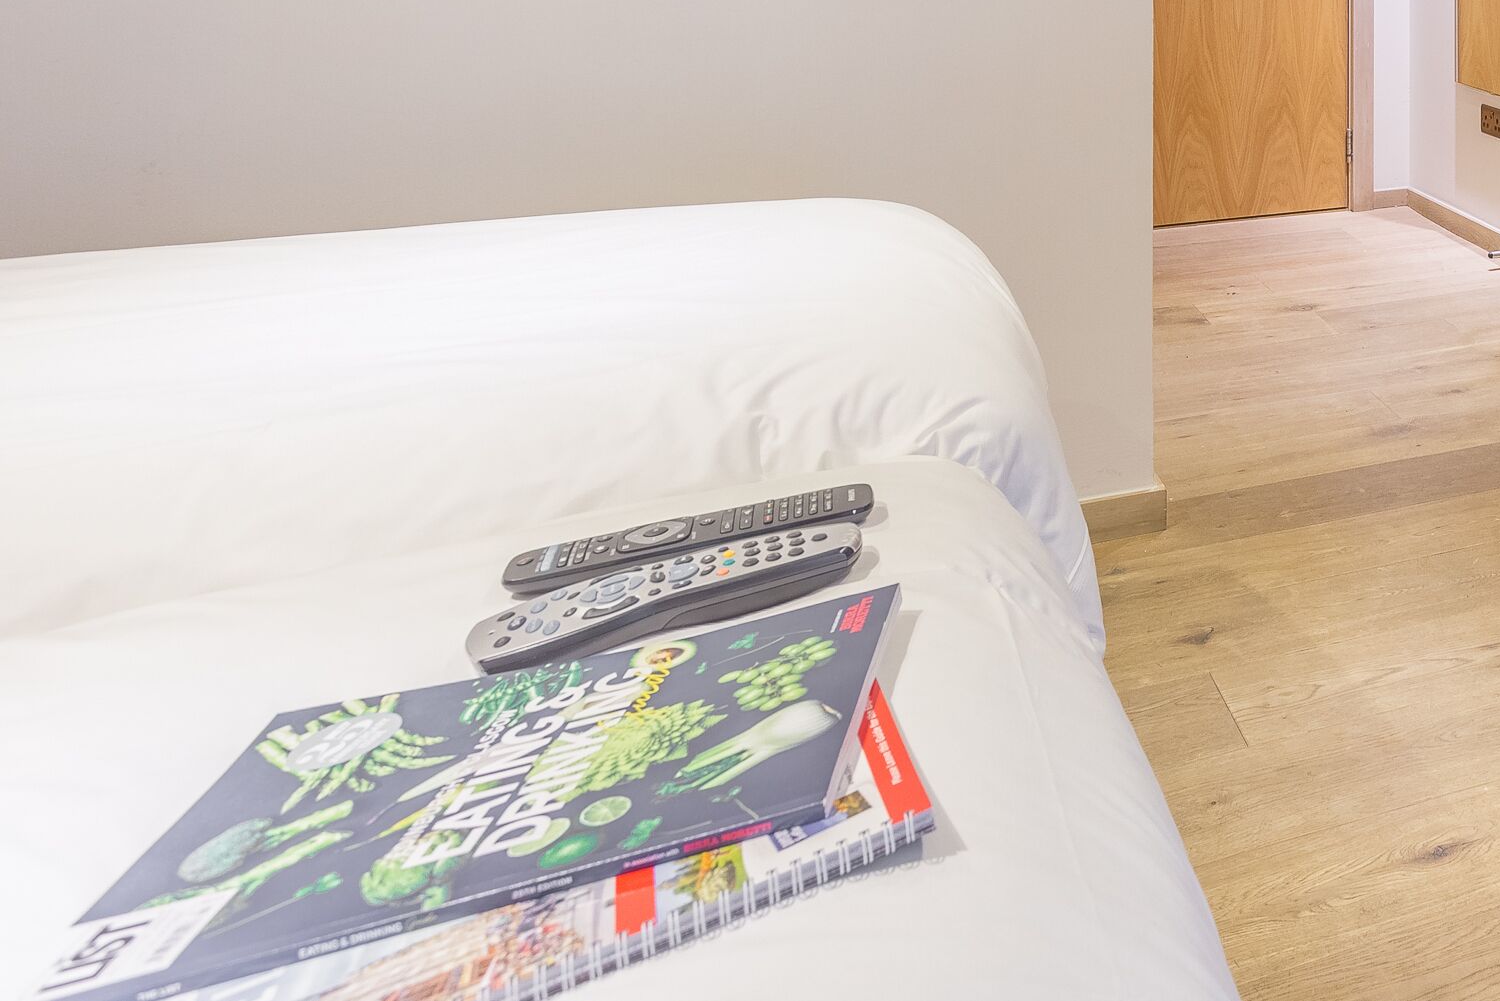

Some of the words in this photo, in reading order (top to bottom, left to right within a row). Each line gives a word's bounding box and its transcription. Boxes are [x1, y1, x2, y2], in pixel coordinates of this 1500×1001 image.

[401, 715, 566, 869] EATING
[525, 680, 595, 713] &
[472, 665, 653, 858] DRINKING
[298, 941, 340, 960] EATING
[351, 921, 403, 945] DRINKING
